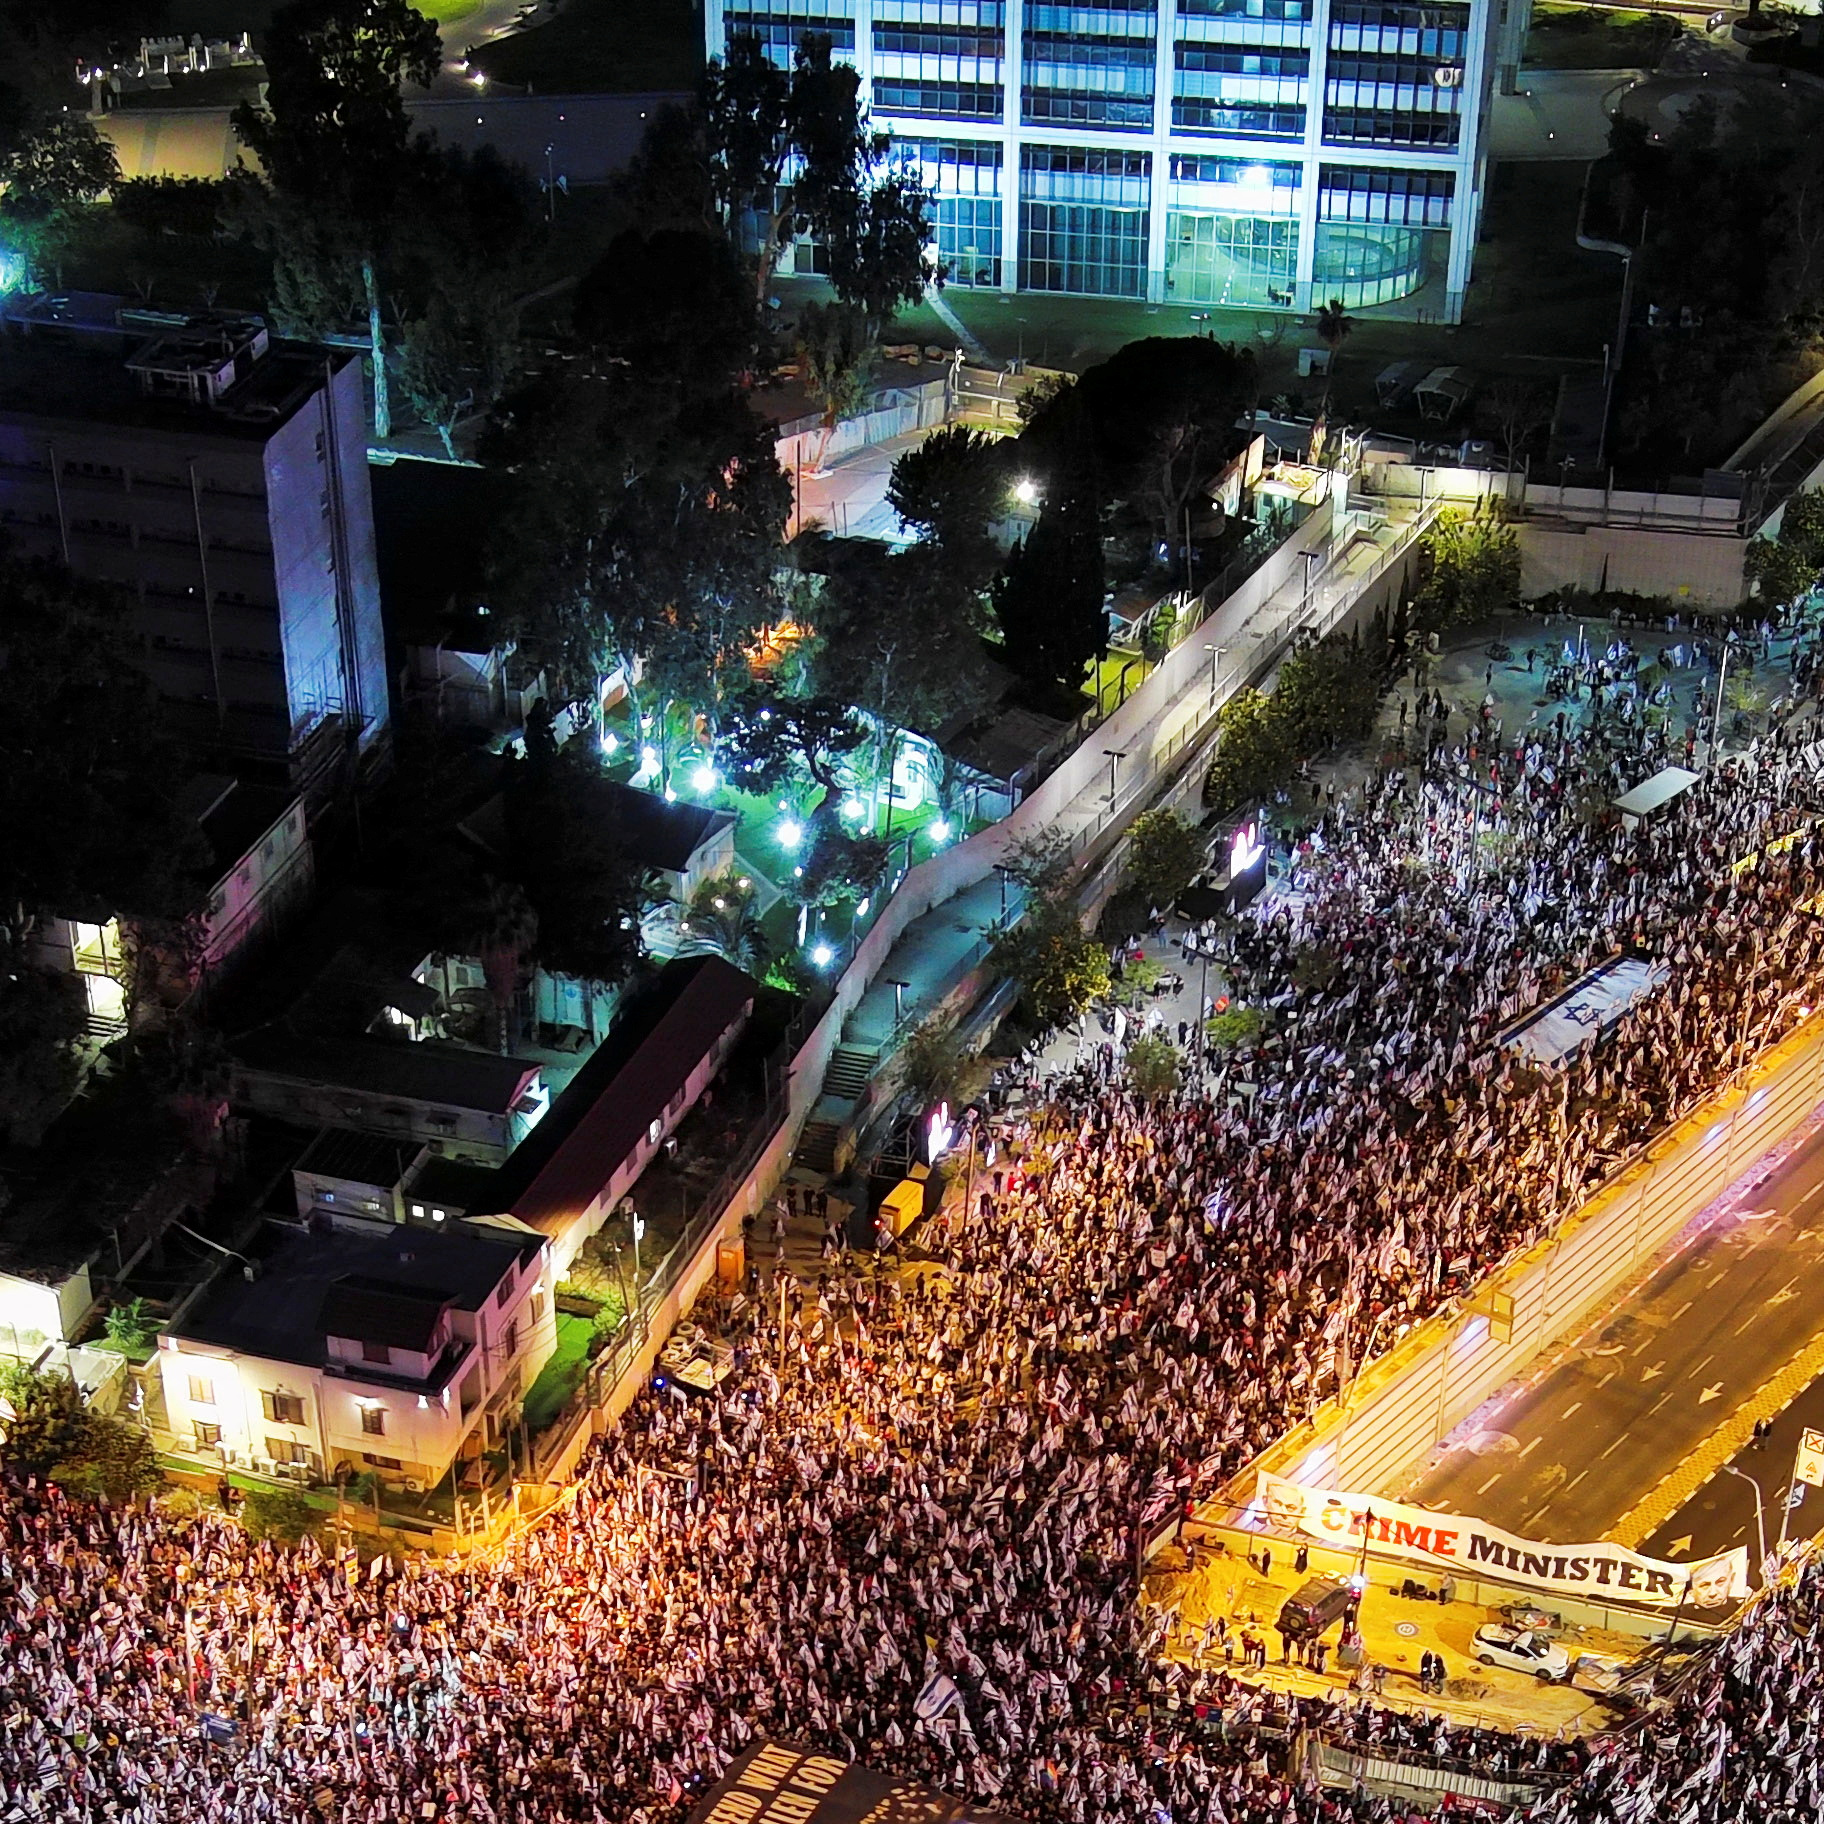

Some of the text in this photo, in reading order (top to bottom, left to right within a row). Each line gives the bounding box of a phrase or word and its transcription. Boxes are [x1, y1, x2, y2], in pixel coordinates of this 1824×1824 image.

[1321, 1505, 1675, 1597] CRIME MINISTER
[736, 1743, 803, 1791] WHAT
[789, 1756, 849, 1794] FOR
